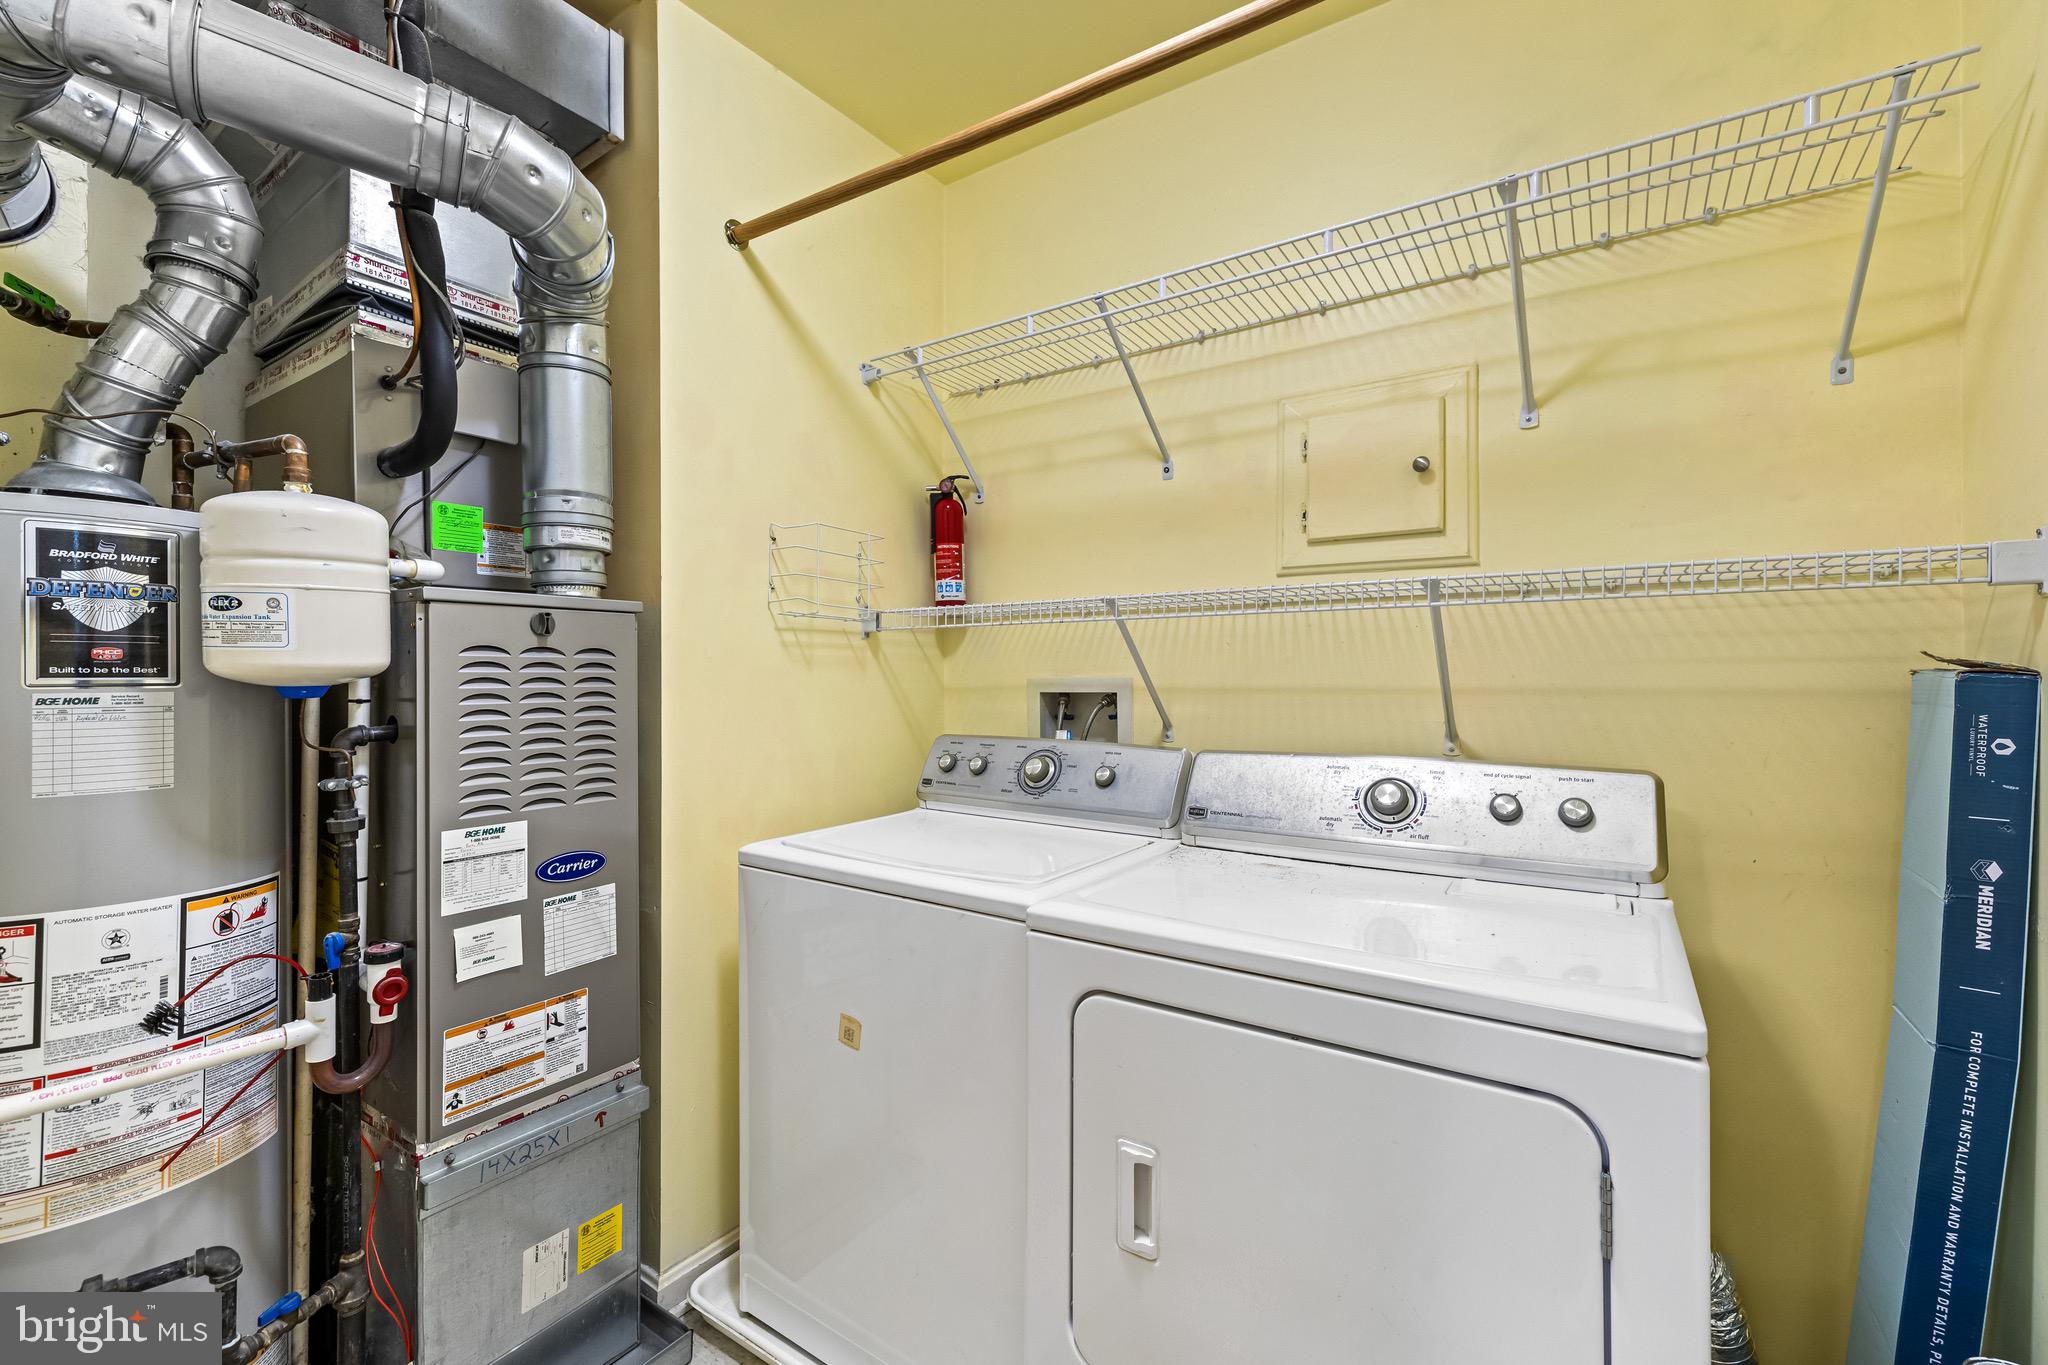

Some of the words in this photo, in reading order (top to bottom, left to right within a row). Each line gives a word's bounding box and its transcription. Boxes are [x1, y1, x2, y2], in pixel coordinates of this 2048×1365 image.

[49, 548, 117, 560] BRADFORD
[121, 554, 158, 564] WHITE
[28, 577, 178, 603] DEFENDER
[51, 602, 102, 612] SAFETY
[106, 604, 156, 614] SYSTEM
[35, 698, 60, 706] BGE
[62, 697, 100, 705] HOME
[1976, 714, 1989, 778] WATERPROOF
[465, 829, 482, 838] BGE
[482, 826, 506, 836] HOME
[547, 857, 598, 876] Carrier
[231, 890, 257, 900] WARNING
[544, 898, 557, 908] BGE
[557, 894, 577, 905] HOME
[54, 916, 94, 926] AUTOMATIC
[94, 911, 126, 922] STORAGE
[126, 908, 149, 917] WATER
[149, 904, 173, 914] HEATER
[1976, 884, 1995, 952] MERIDIAN
[1969, 1030, 1982, 1054] FOR
[96, 1058, 127, 1070] OPERATING
[128, 1048, 167, 1064] INSTRUCTIONS
[151, 1060, 172, 1072] ASTM
[1962, 1055, 1980, 1116] COMPLETE
[93, 1140, 108, 1148] TURN
[143, 1120, 172, 1133] APPLIANCE
[1950, 1120, 1972, 1202] INSTALLATION
[1948, 1204, 1961, 1228] AND
[1941, 1232, 1958, 1296] WARRANTY
[1930, 1295, 1949, 1347] DETAILS,
